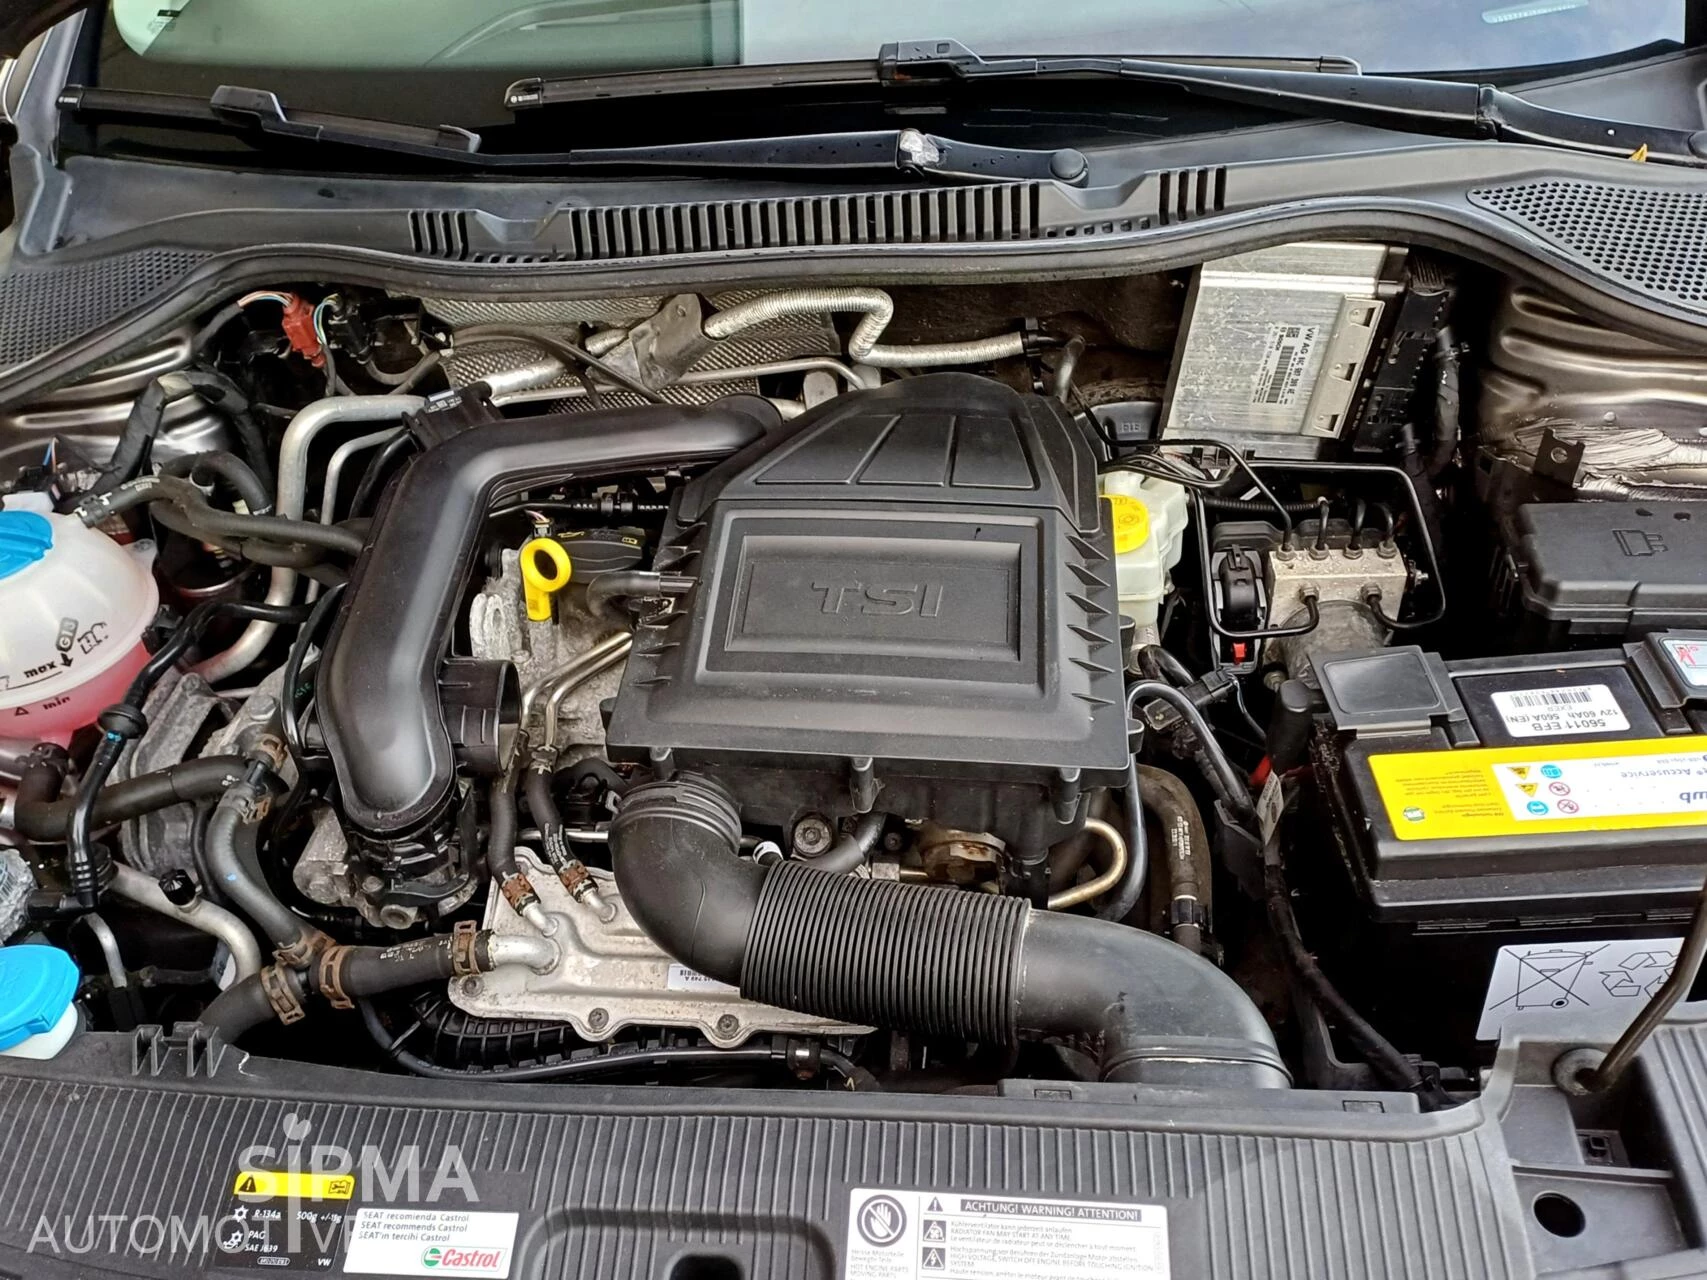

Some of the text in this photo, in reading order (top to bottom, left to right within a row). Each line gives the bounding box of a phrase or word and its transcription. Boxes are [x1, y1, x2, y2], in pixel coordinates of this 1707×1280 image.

[1304, 326, 1316, 341] VW
[1300, 342, 1310, 354] AG
[810, 581, 944, 619] TSI
[23, 660, 57, 679] max
[42, 695, 71, 711] min
[1505, 708, 1619, 724] 12V 60Ah 560A (EN)
[1531, 718, 1607, 732] 56011 EFB
[1620, 768, 1691, 778] Accuservice
[253, 1209, 282, 1219] R-134a
[296, 1210, 319, 1223] 500g
[363, 1211, 471, 1222] SEAT recomienda Castrol
[965, 1201, 1138, 1221] ACHTUNG! WARNING! ATTENTION!
[360, 1221, 468, 1233] SEAT recommends Castrol
[248, 1230, 266, 1240] PAG
[391, 1233, 418, 1241] tercihi
[420, 1233, 450, 1242] Castrol
[244, 1243, 279, 1253] SAE J639
[317, 1258, 332, 1267] VW
[442, 1248, 502, 1268] Castrol
